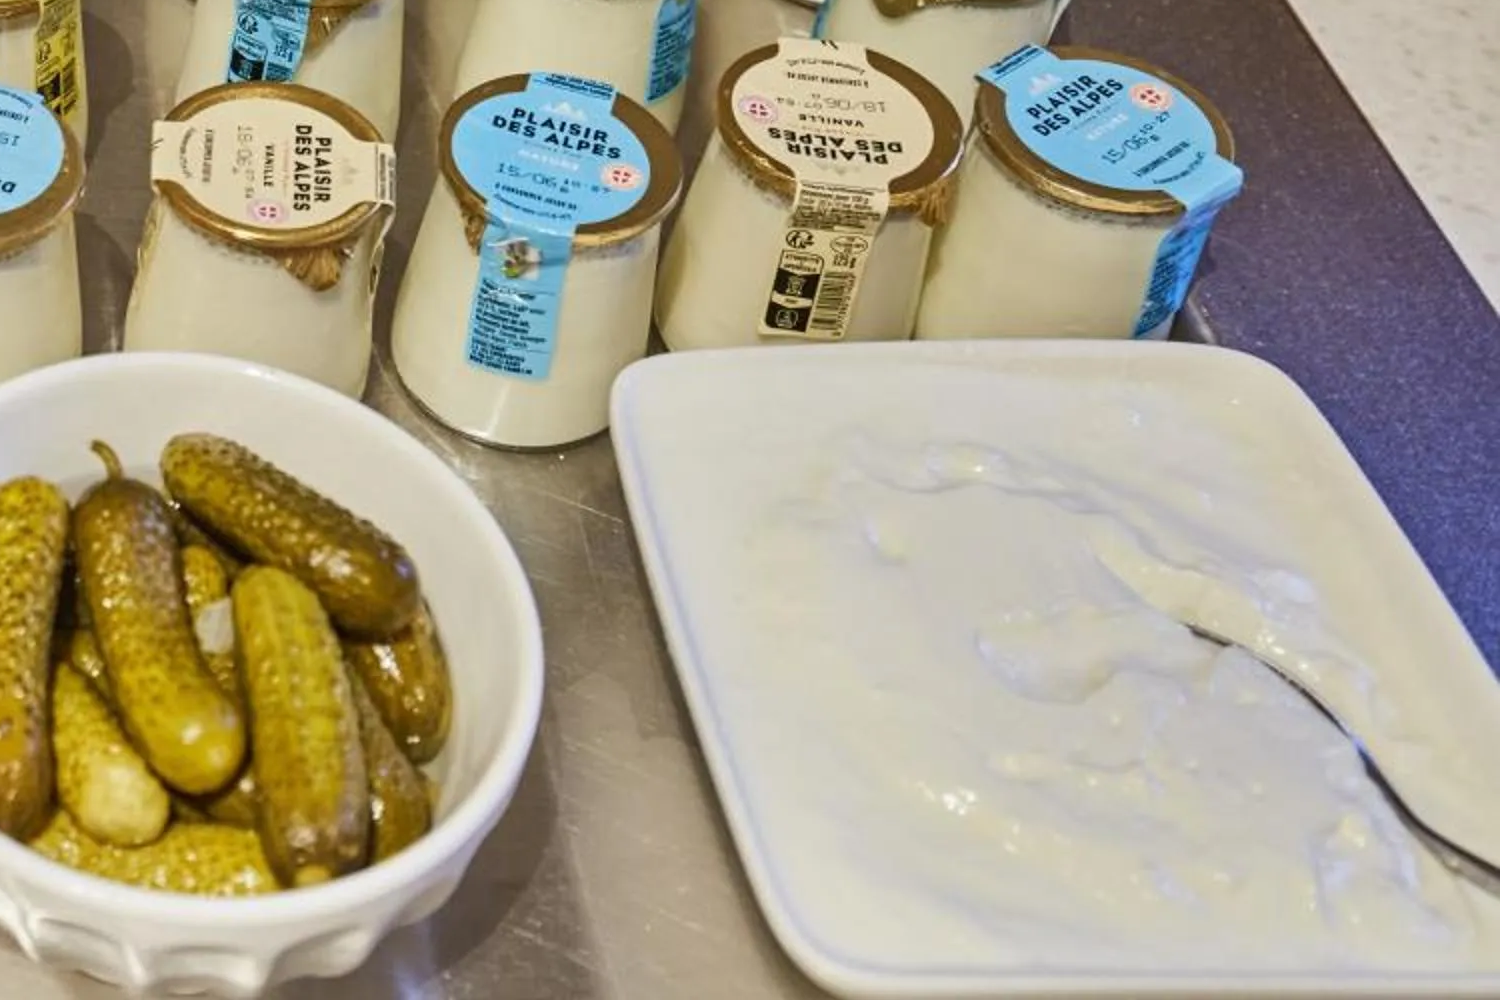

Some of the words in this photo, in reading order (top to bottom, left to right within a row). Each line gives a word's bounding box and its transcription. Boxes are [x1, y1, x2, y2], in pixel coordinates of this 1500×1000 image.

[1025, 74, 1098, 120] PLAISIR
[1032, 112, 1070, 138] DES
[1070, 77, 1125, 116] ALPES
[491, 114, 537, 139] DES
[543, 130, 622, 160] ALPES
[511, 106, 610, 143] PLAISIR
[766, 126, 846, 149] ALPES
[798, 112, 866, 129] VANILLE
[294, 124, 313, 156] DES
[787, 142, 890, 165] PLAISIR
[855, 139, 904, 154] DES
[292, 160, 312, 212] ALPES
[312, 136, 332, 204] PLAISIR
